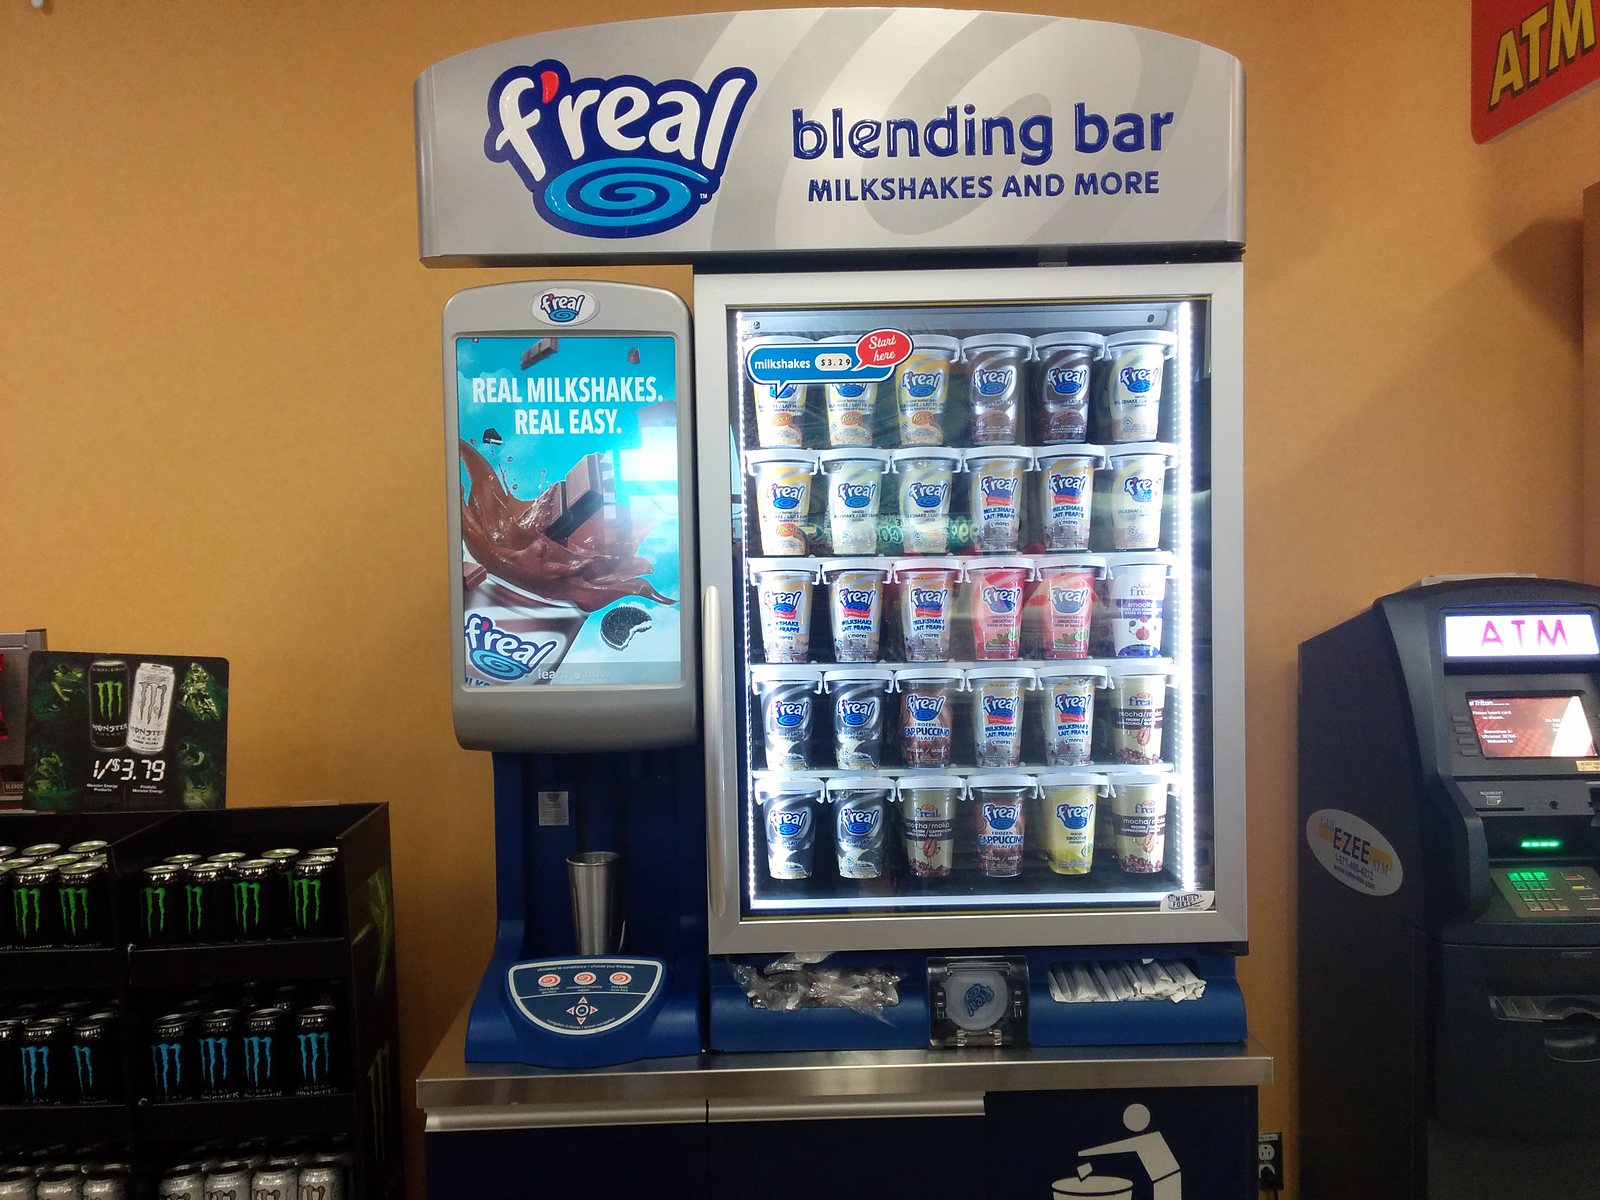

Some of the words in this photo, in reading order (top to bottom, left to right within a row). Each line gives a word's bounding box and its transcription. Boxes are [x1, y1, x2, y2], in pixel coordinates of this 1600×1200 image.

[1487, 0, 1596, 112] ATM
[490, 65, 753, 184] f'real
[792, 102, 1053, 166] blending
[1075, 101, 1175, 155] bar
[808, 174, 994, 203] MILKSHAKES
[1002, 172, 1067, 199] AND
[1074, 169, 1160, 197] MORE
[541, 293, 585, 316] f'real
[868, 335, 897, 350] Start
[754, 358, 811, 370] milkshakes
[820, 358, 851, 367] $3.29
[873, 350, 895, 362] here
[902, 371, 942, 390] f'real
[974, 369, 1012, 389] f'real
[1048, 368, 1087, 386] f'real
[472, 377, 522, 403] REAL
[527, 376, 663, 403] MILKSHAKES.
[515, 409, 564, 435] REAL
[569, 408, 622, 434] EASY.
[838, 483, 876, 500] f'real
[910, 482, 948, 501] f'real
[981, 476, 1018, 496] f'real
[1049, 474, 1087, 493] f'real
[839, 588, 876, 606] f'real
[911, 588, 948, 607] f'real
[983, 586, 1020, 605] f'real
[1050, 586, 1088, 605] f'real
[466, 614, 557, 668] f'real
[1481, 619, 1569, 648] ATM
[907, 695, 945, 714] f'real
[983, 695, 1019, 715] f'real
[904, 727, 950, 738] CAPPUCCINO
[983, 803, 1022, 821] f'real
[1333, 826, 1371, 865] EZEE
[1175, 895, 1197, 903] MINUS
